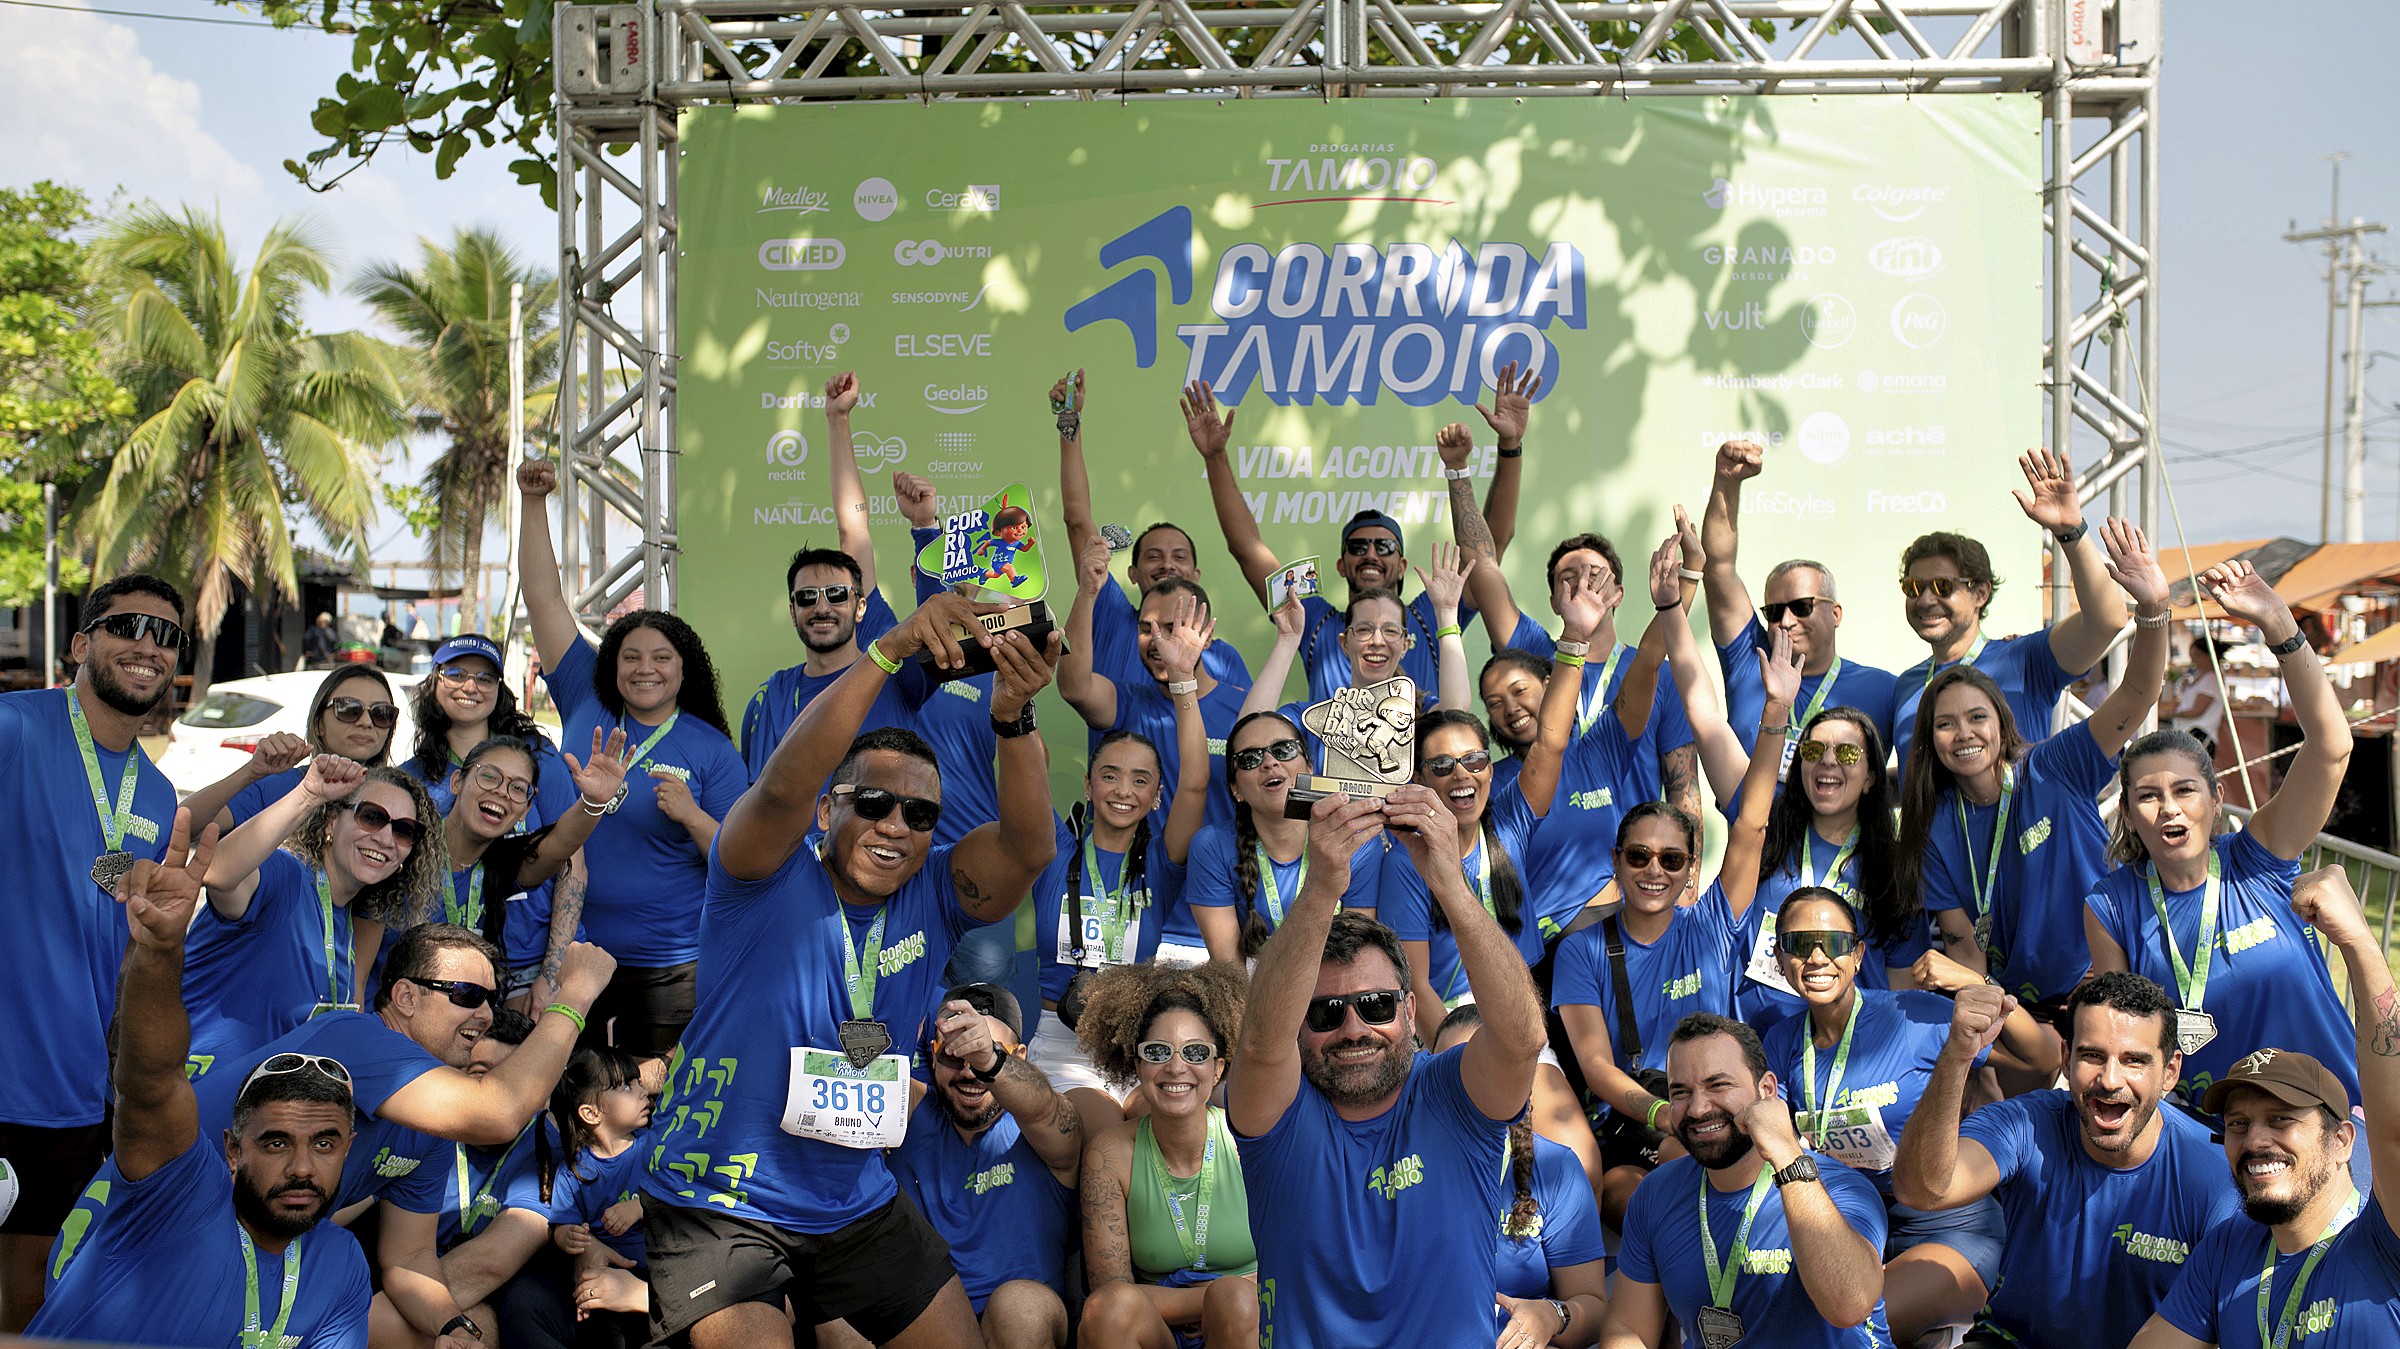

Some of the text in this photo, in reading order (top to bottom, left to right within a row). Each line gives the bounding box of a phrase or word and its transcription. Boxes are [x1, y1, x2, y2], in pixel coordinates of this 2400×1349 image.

[1309, 143, 1396, 154] DROGARIAS
[1265, 156, 1438, 192] TAMOIO
[857, 194, 895, 205] NIVEA
[925, 186, 1000, 210] CeraVe
[1738, 183, 1828, 210] Hypera
[1851, 183, 1947, 206] Colgate
[764, 244, 839, 265] CIMED
[1702, 246, 1837, 266] GRANADO
[1210, 238, 1580, 324] CORRIDA
[1731, 272, 1774, 281] DESDE
[755, 288, 861, 311] Neutrogena
[891, 291, 970, 304] SENSODYNE
[1702, 301, 1766, 331] vult
[766, 340, 837, 366] Softys
[894, 333, 993, 358] ELSEVE
[1175, 323, 1548, 394] TAMOIO
[1716, 373, 1844, 391] Kimberly-Clark
[1882, 373, 1948, 389] emana
[857, 391, 879, 409] AX
[923, 383, 988, 402] Geolab
[852, 444, 900, 457] EMS
[927, 459, 985, 473] darrow
[1238, 445, 1498, 479] VIDA ACONTCE
[767, 469, 807, 481] reckitt
[753, 506, 836, 525] NANLAC
[1271, 490, 1451, 524] MOVIMENT
[945, 508, 984, 534] COR
[942, 551, 969, 571] DA
[940, 564, 980, 582] TAMOIO
[652, 763, 691, 782] CORRIDA
[1338, 780, 1374, 795] TAMOIO
[127, 812, 160, 837] CORRIDA
[878, 930, 927, 964] CORRIDA
[877, 944, 925, 977] TAMOIO
[835, 1067, 867, 1078] TAMOIO
[811, 1078, 885, 1114] 3618
[834, 1116, 862, 1128] BRUNO
[385, 1154, 422, 1170] CORRID
[976, 1161, 1016, 1184] CORRIDA
[2126, 1240, 2186, 1264] TAMOIO
[2131, 1231, 2190, 1256] CORRIDA
[1746, 1248, 1792, 1263] CORRIDA
